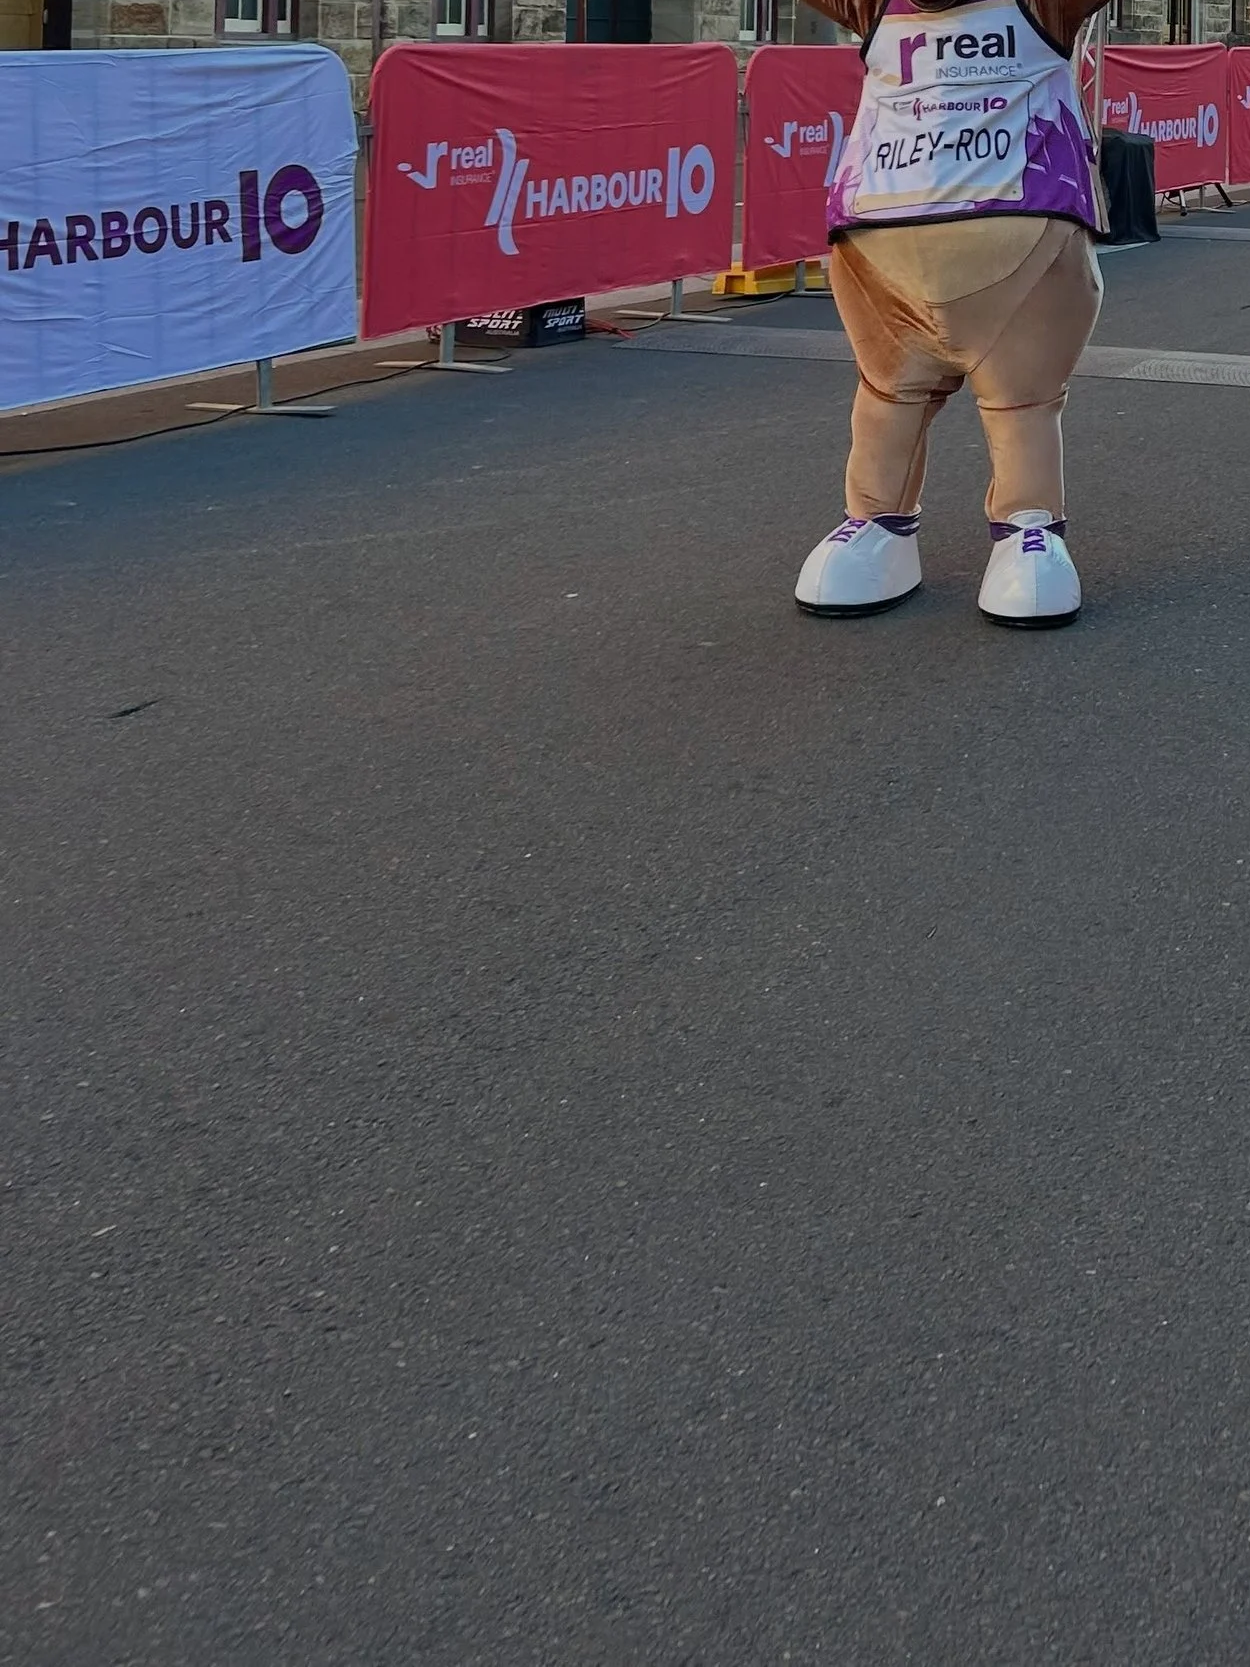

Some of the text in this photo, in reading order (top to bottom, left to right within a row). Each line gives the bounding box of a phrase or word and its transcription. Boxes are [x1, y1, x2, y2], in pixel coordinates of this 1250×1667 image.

[935, 25, 1016, 61] real
[922, 102, 981, 114] HARBOUR
[1111, 97, 1129, 115] real
[800, 119, 828, 143] real
[1140, 103, 1219, 148] HARBOUR 10
[451, 138, 493, 170] real
[874, 128, 1011, 173] RILEY-ROO
[525, 143, 715, 219] HARBOUR 10
[0, 163, 324, 271] HARBOUR 10
[467, 318, 523, 330] SPORT
[544, 314, 585, 329] SPORT
